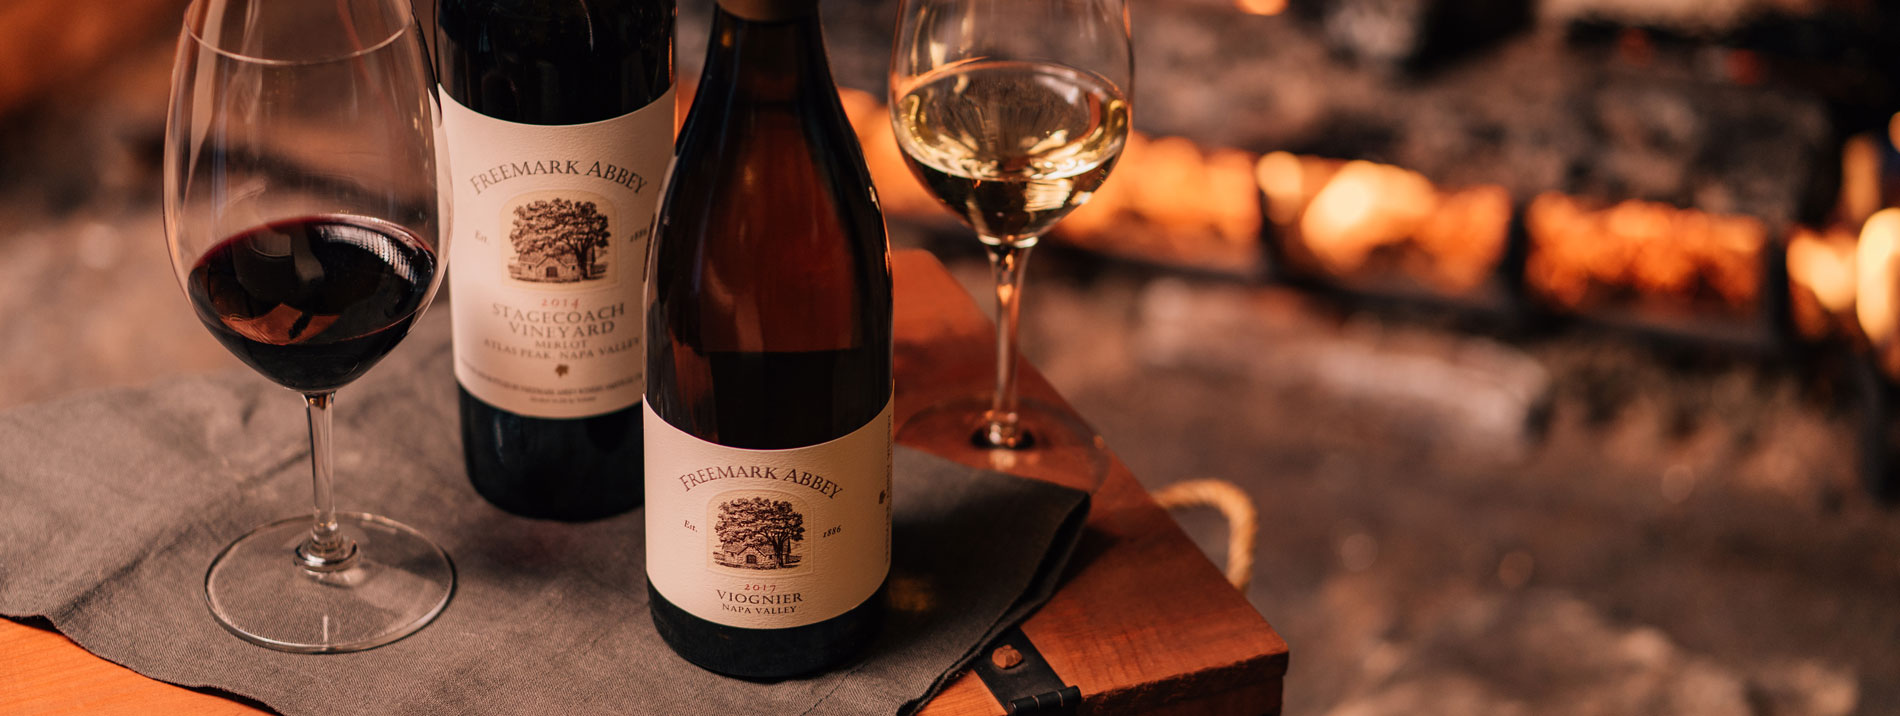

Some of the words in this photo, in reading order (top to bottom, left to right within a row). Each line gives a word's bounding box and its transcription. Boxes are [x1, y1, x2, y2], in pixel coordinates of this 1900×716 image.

[470, 160, 579, 195] FREEMARK
[585, 160, 648, 194] ABBEY
[541, 298, 580, 309] 2014
[492, 303, 625, 324] STAGECOACH
[509, 321, 615, 338] VINEYARD
[483, 338, 517, 356] ATLAS
[560, 351, 595, 360] NAPA
[599, 337, 640, 356] VALLEY
[535, 338, 588, 349] MERLOT
[679, 465, 778, 492] FREEMARK
[784, 468, 843, 500] ABBEY
[684, 520, 698, 532] Est.
[823, 525, 842, 538] 1886
[744, 583, 776, 593] 2017
[716, 589, 803, 605] VIOGNIER
[722, 603, 751, 614] NAPA
[756, 605, 797, 614] VALLEY
